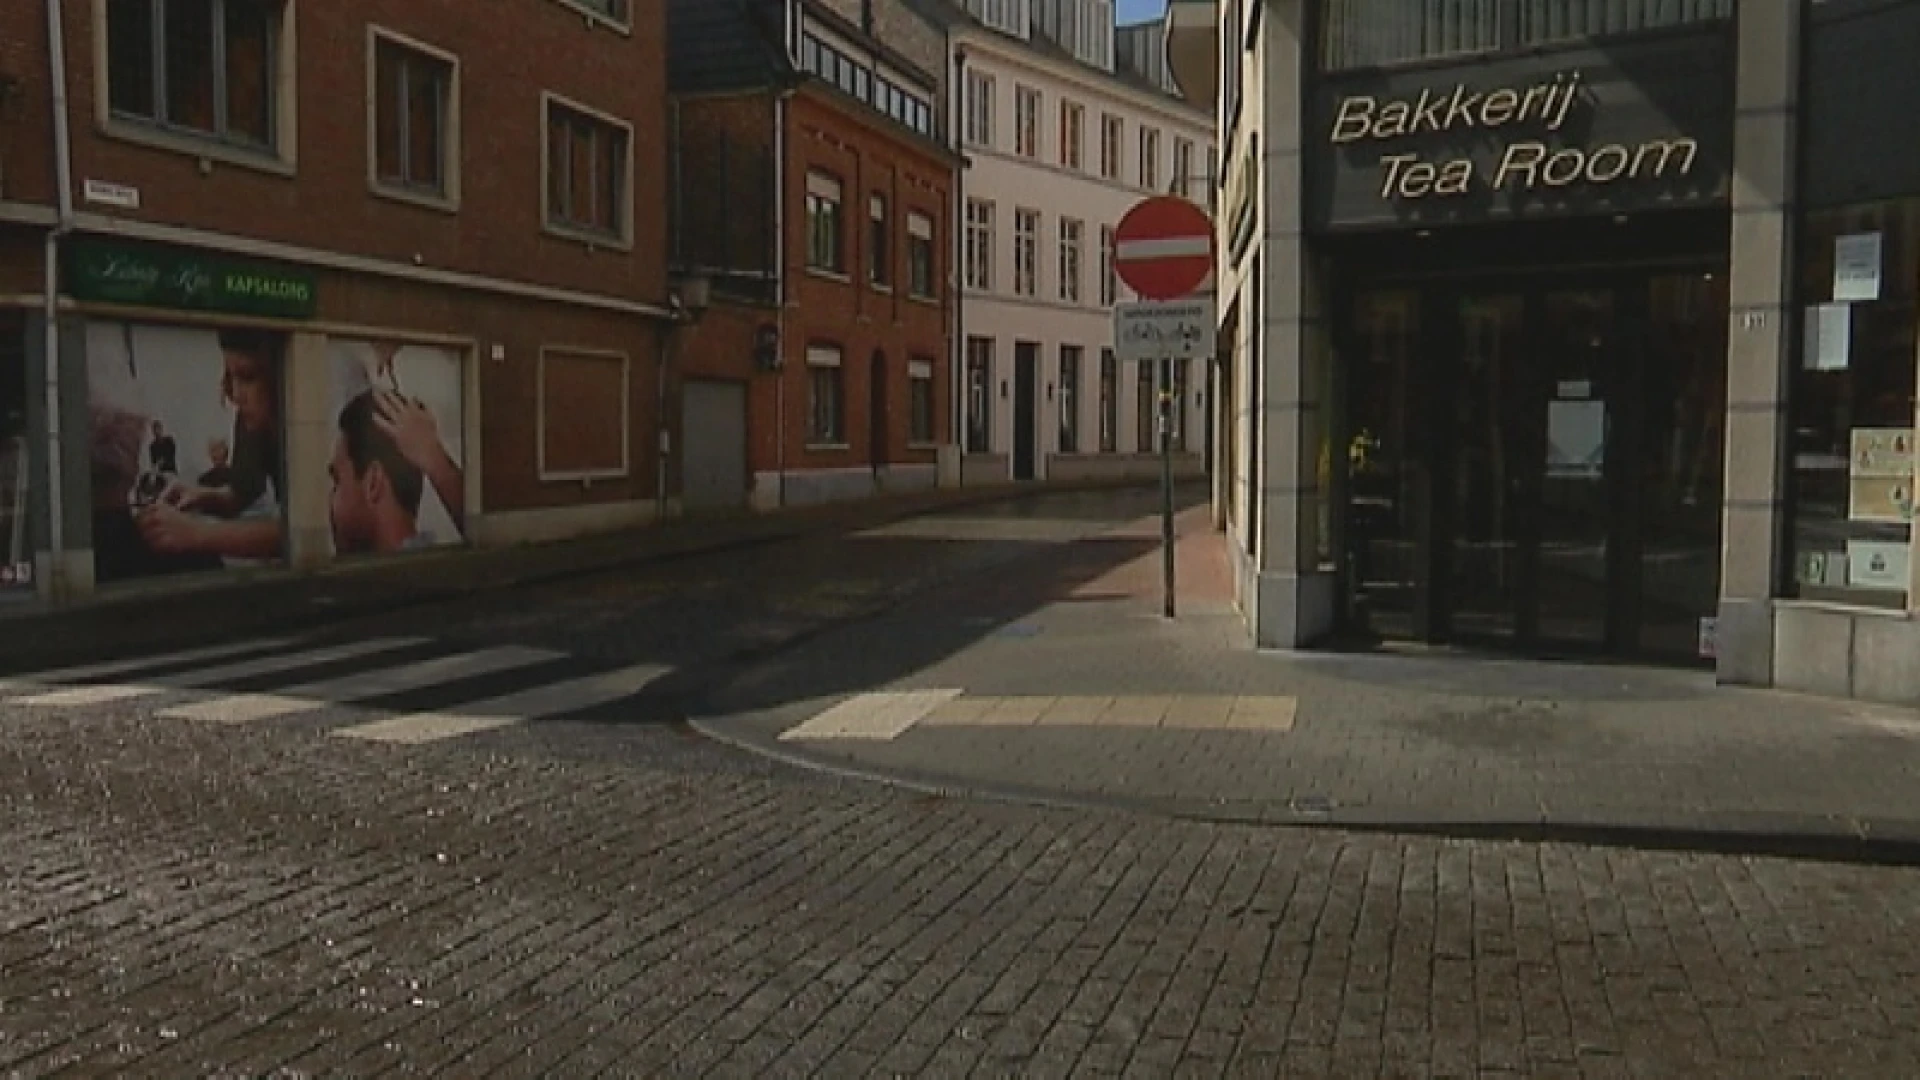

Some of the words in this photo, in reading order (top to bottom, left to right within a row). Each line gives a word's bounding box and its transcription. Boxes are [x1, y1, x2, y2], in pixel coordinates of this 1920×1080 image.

[1330, 71, 1580, 142] Bakkerij
[1380, 153, 1472, 198] Tea
[1493, 136, 1698, 189] Room
